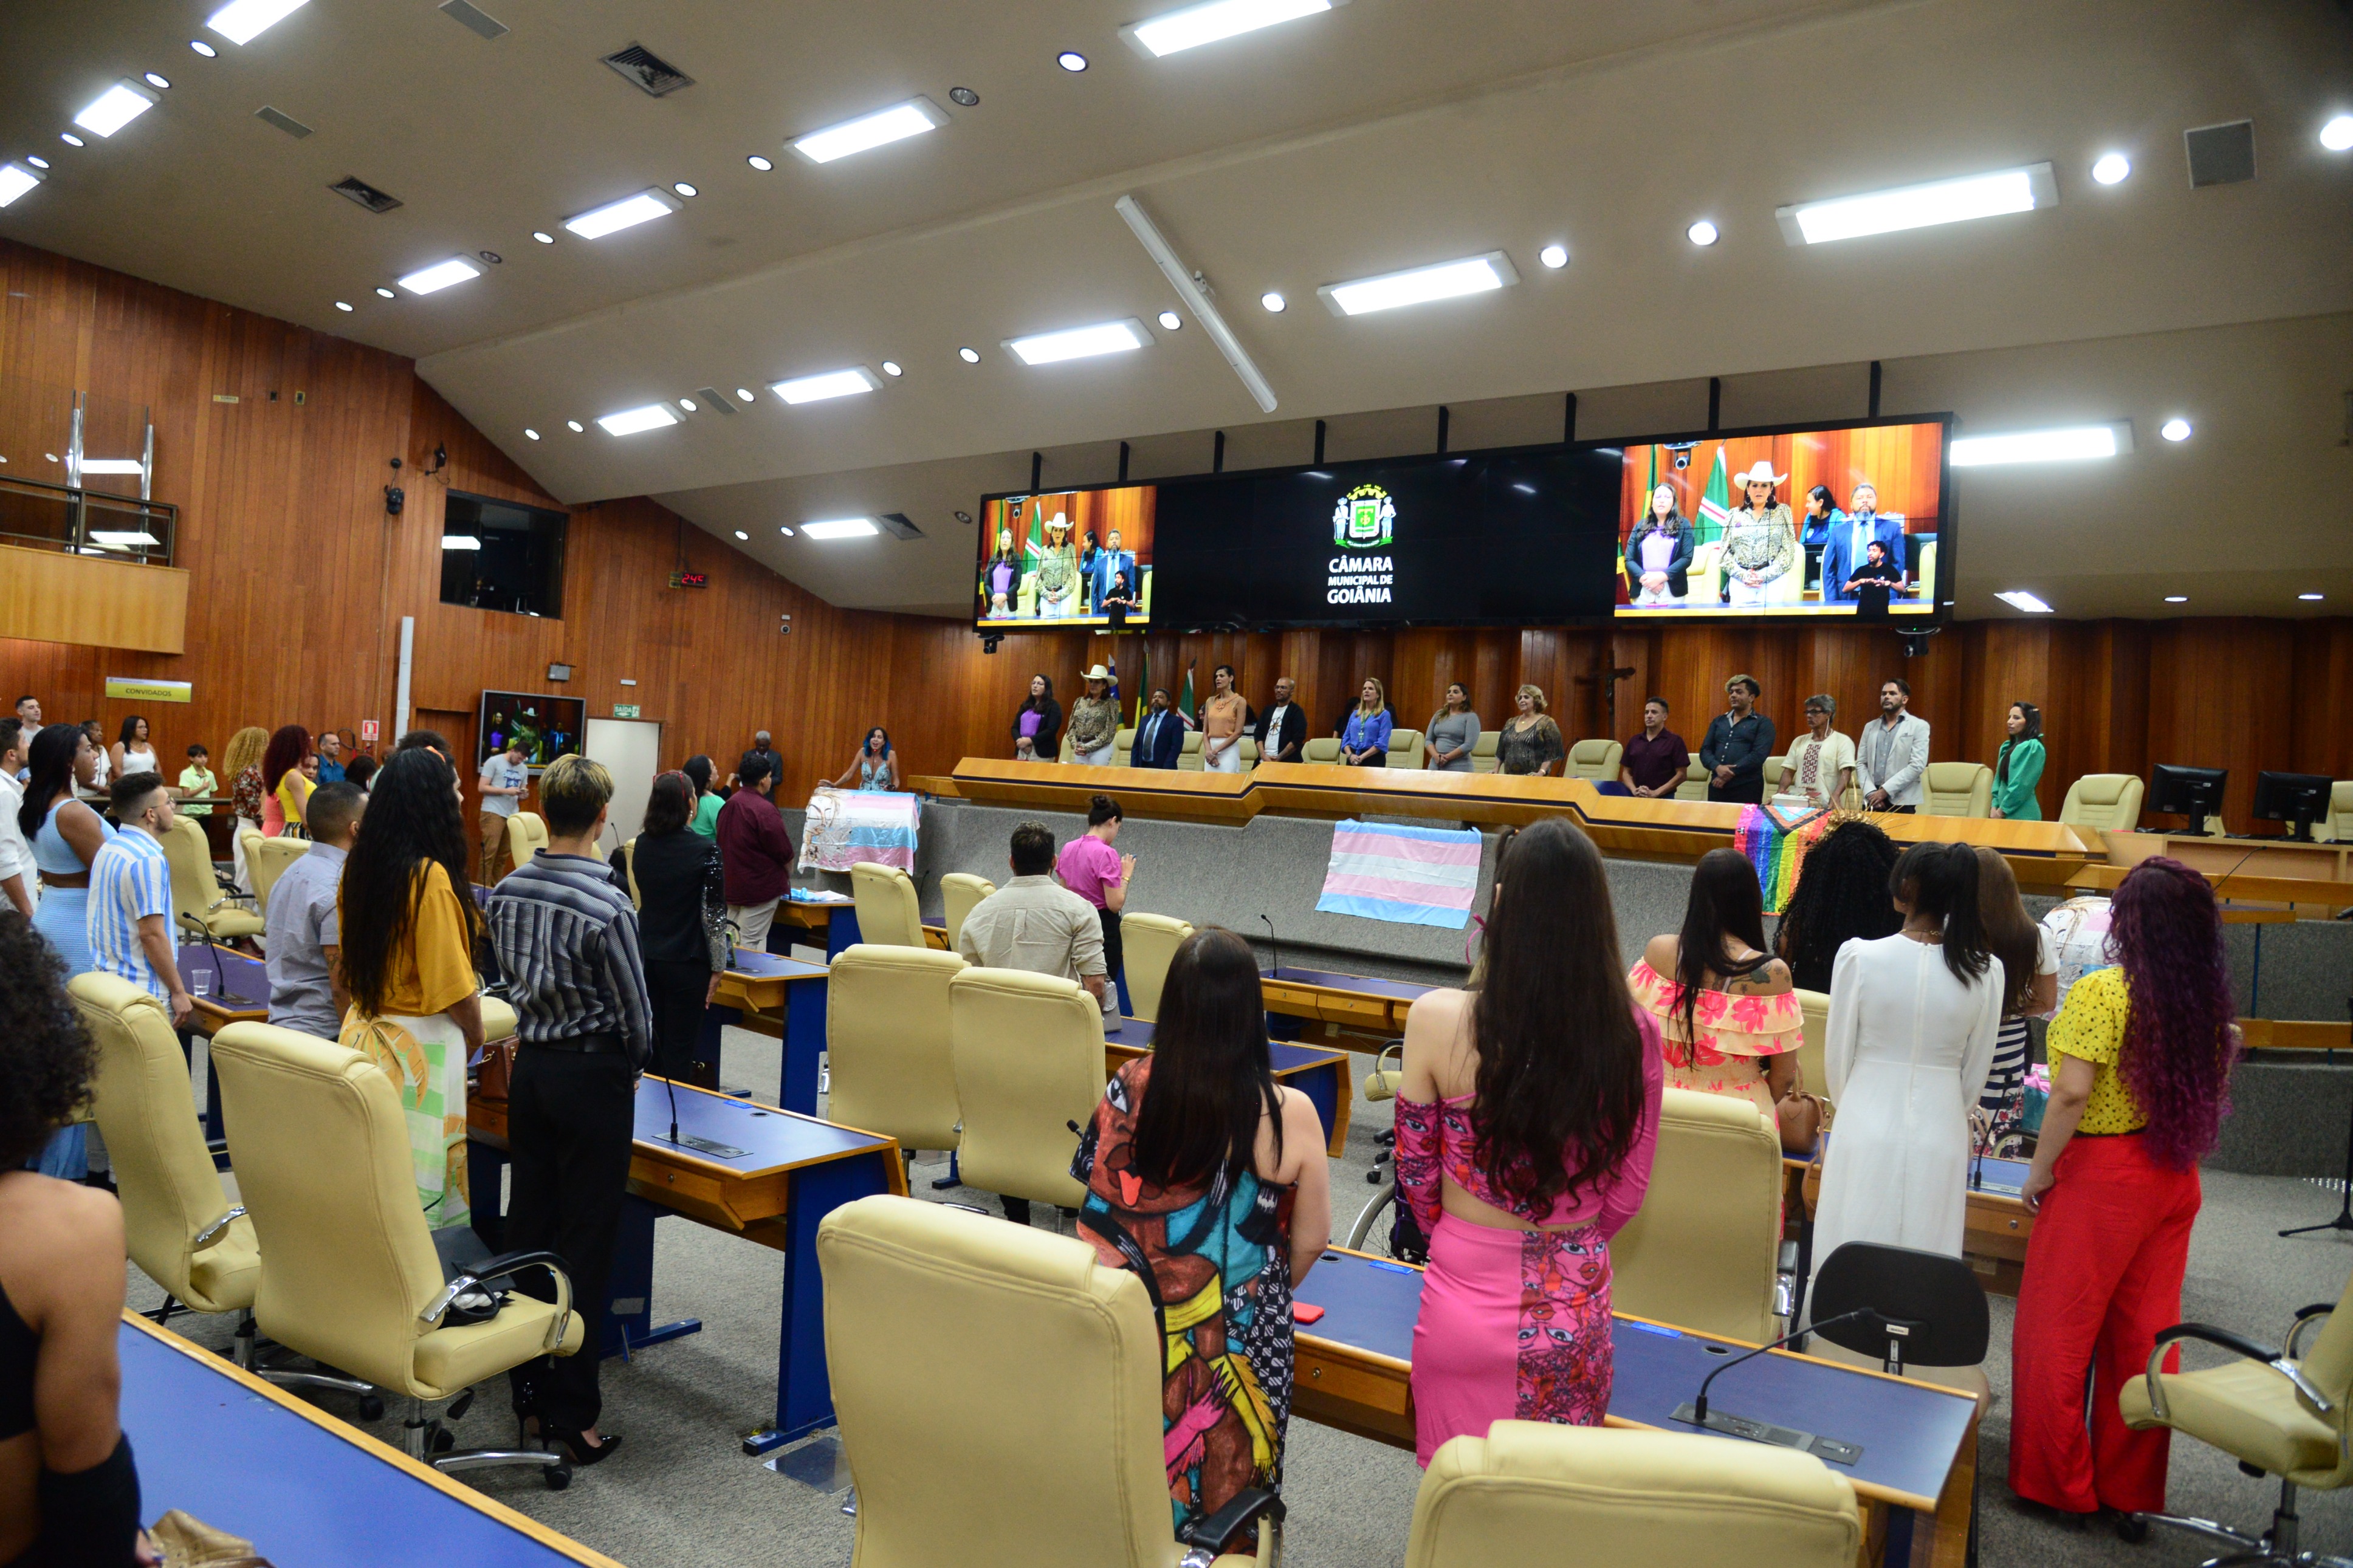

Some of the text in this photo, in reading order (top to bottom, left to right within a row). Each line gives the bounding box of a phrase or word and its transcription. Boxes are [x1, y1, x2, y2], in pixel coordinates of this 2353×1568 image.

[1328, 555, 1393, 573] CÂMARA
[1328, 575, 1393, 586] MUNICIPAL DE
[1327, 585, 1392, 604] GOIÂNIA
[126, 688, 172, 697] CONVIDADOS
